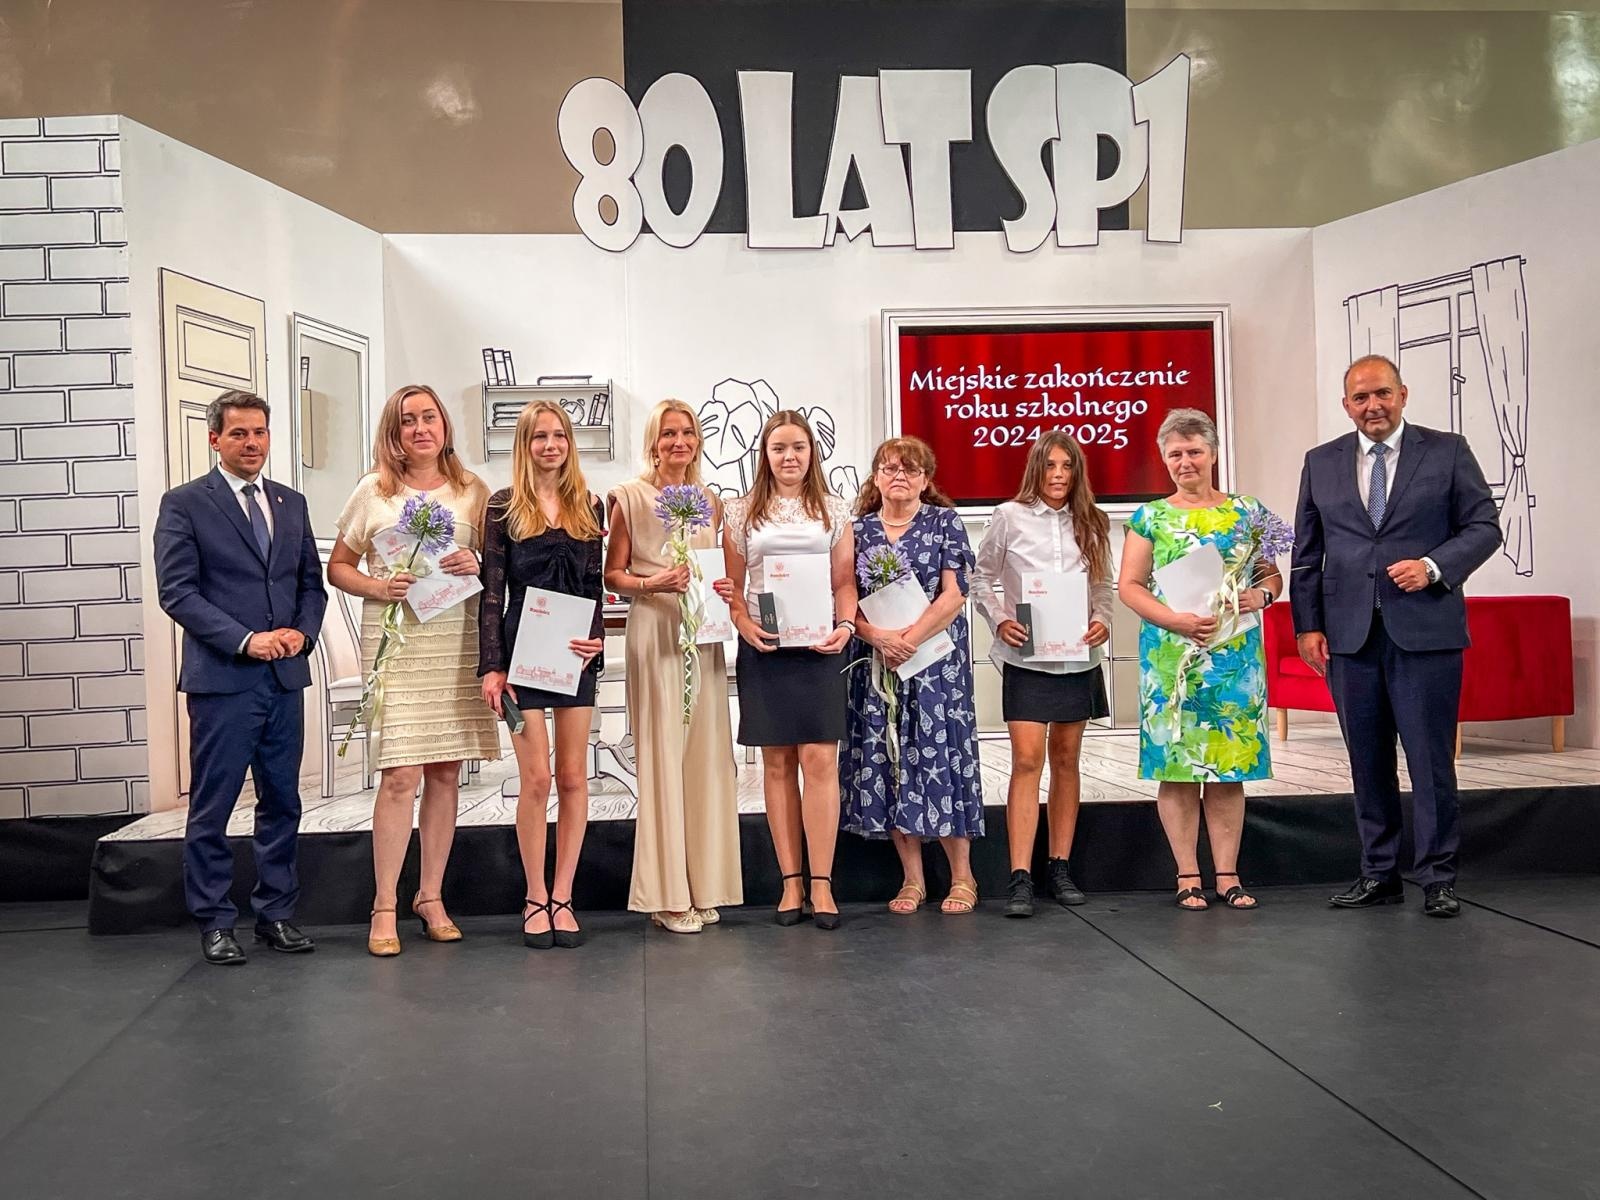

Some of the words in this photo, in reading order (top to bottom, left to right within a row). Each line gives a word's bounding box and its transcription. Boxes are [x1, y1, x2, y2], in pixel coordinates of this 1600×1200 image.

[557, 72, 723, 252] 80
[738, 69, 972, 249] LAT
[986, 54, 1190, 253] SP1
[909, 363, 1018, 399] Miejskie
[1025, 361, 1190, 389] zakończenie
[945, 395, 1009, 419] roku
[1016, 391, 1147, 424] szkolnego
